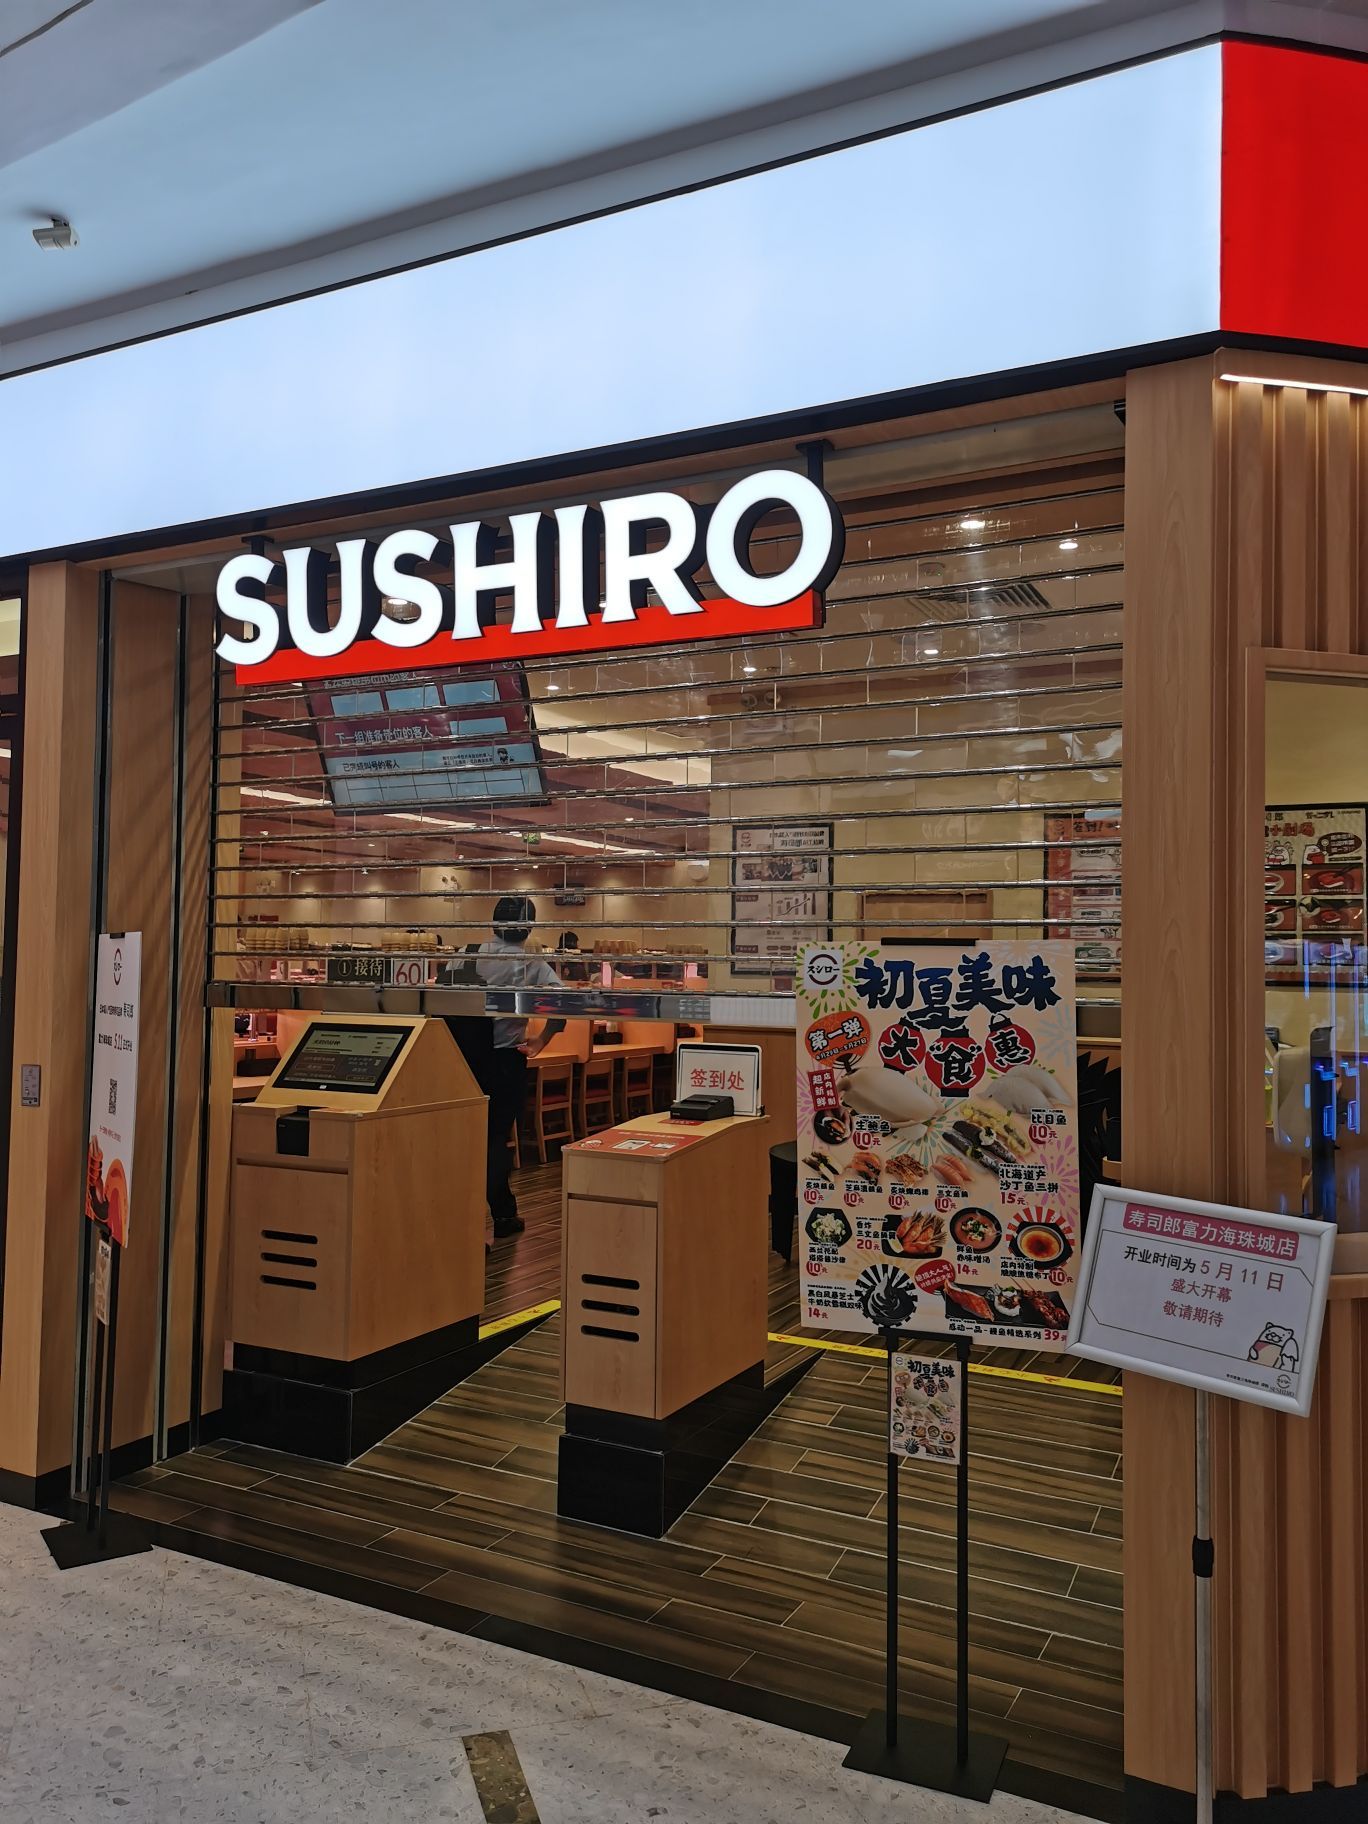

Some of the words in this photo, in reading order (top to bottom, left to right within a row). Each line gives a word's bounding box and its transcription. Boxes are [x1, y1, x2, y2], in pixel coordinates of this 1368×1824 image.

[216, 470, 833, 665] SUSHIRO
[395, 962, 421, 985] 60
[807, 965, 840, 975] スシロー
[855, 953, 1062, 1030] 初夏美味
[808, 1016, 864, 1052] 第一弹
[691, 1069, 745, 1091] 签到处
[856, 1119, 890, 1132] 生鲍鱼
[1032, 1113, 1067, 1125] 比目鱼
[1032, 1125, 1058, 1139] 10元
[856, 1132, 882, 1147] 10元
[1000, 1168, 1047, 1181] 北海道产
[1000, 1180, 1059, 1194] 沙丁鱼三拼
[1001, 1192, 1026, 1206] 15元
[1128, 1209, 1296, 1258] 寿司郎富力海珠城店
[857, 1238, 881, 1251] 20元
[957, 1263, 980, 1276] 14元
[1124, 1245, 1197, 1274] 开业时间为
[1200, 1260, 1211, 1276] 5
[1215, 1262, 1233, 1282] 月
[1241, 1267, 1258, 1286] 11
[1266, 1271, 1285, 1293] 日
[1170, 1277, 1233, 1304] 盛大开幕
[808, 1306, 829, 1319] 14元
[1162, 1299, 1225, 1328] 敬请期待
